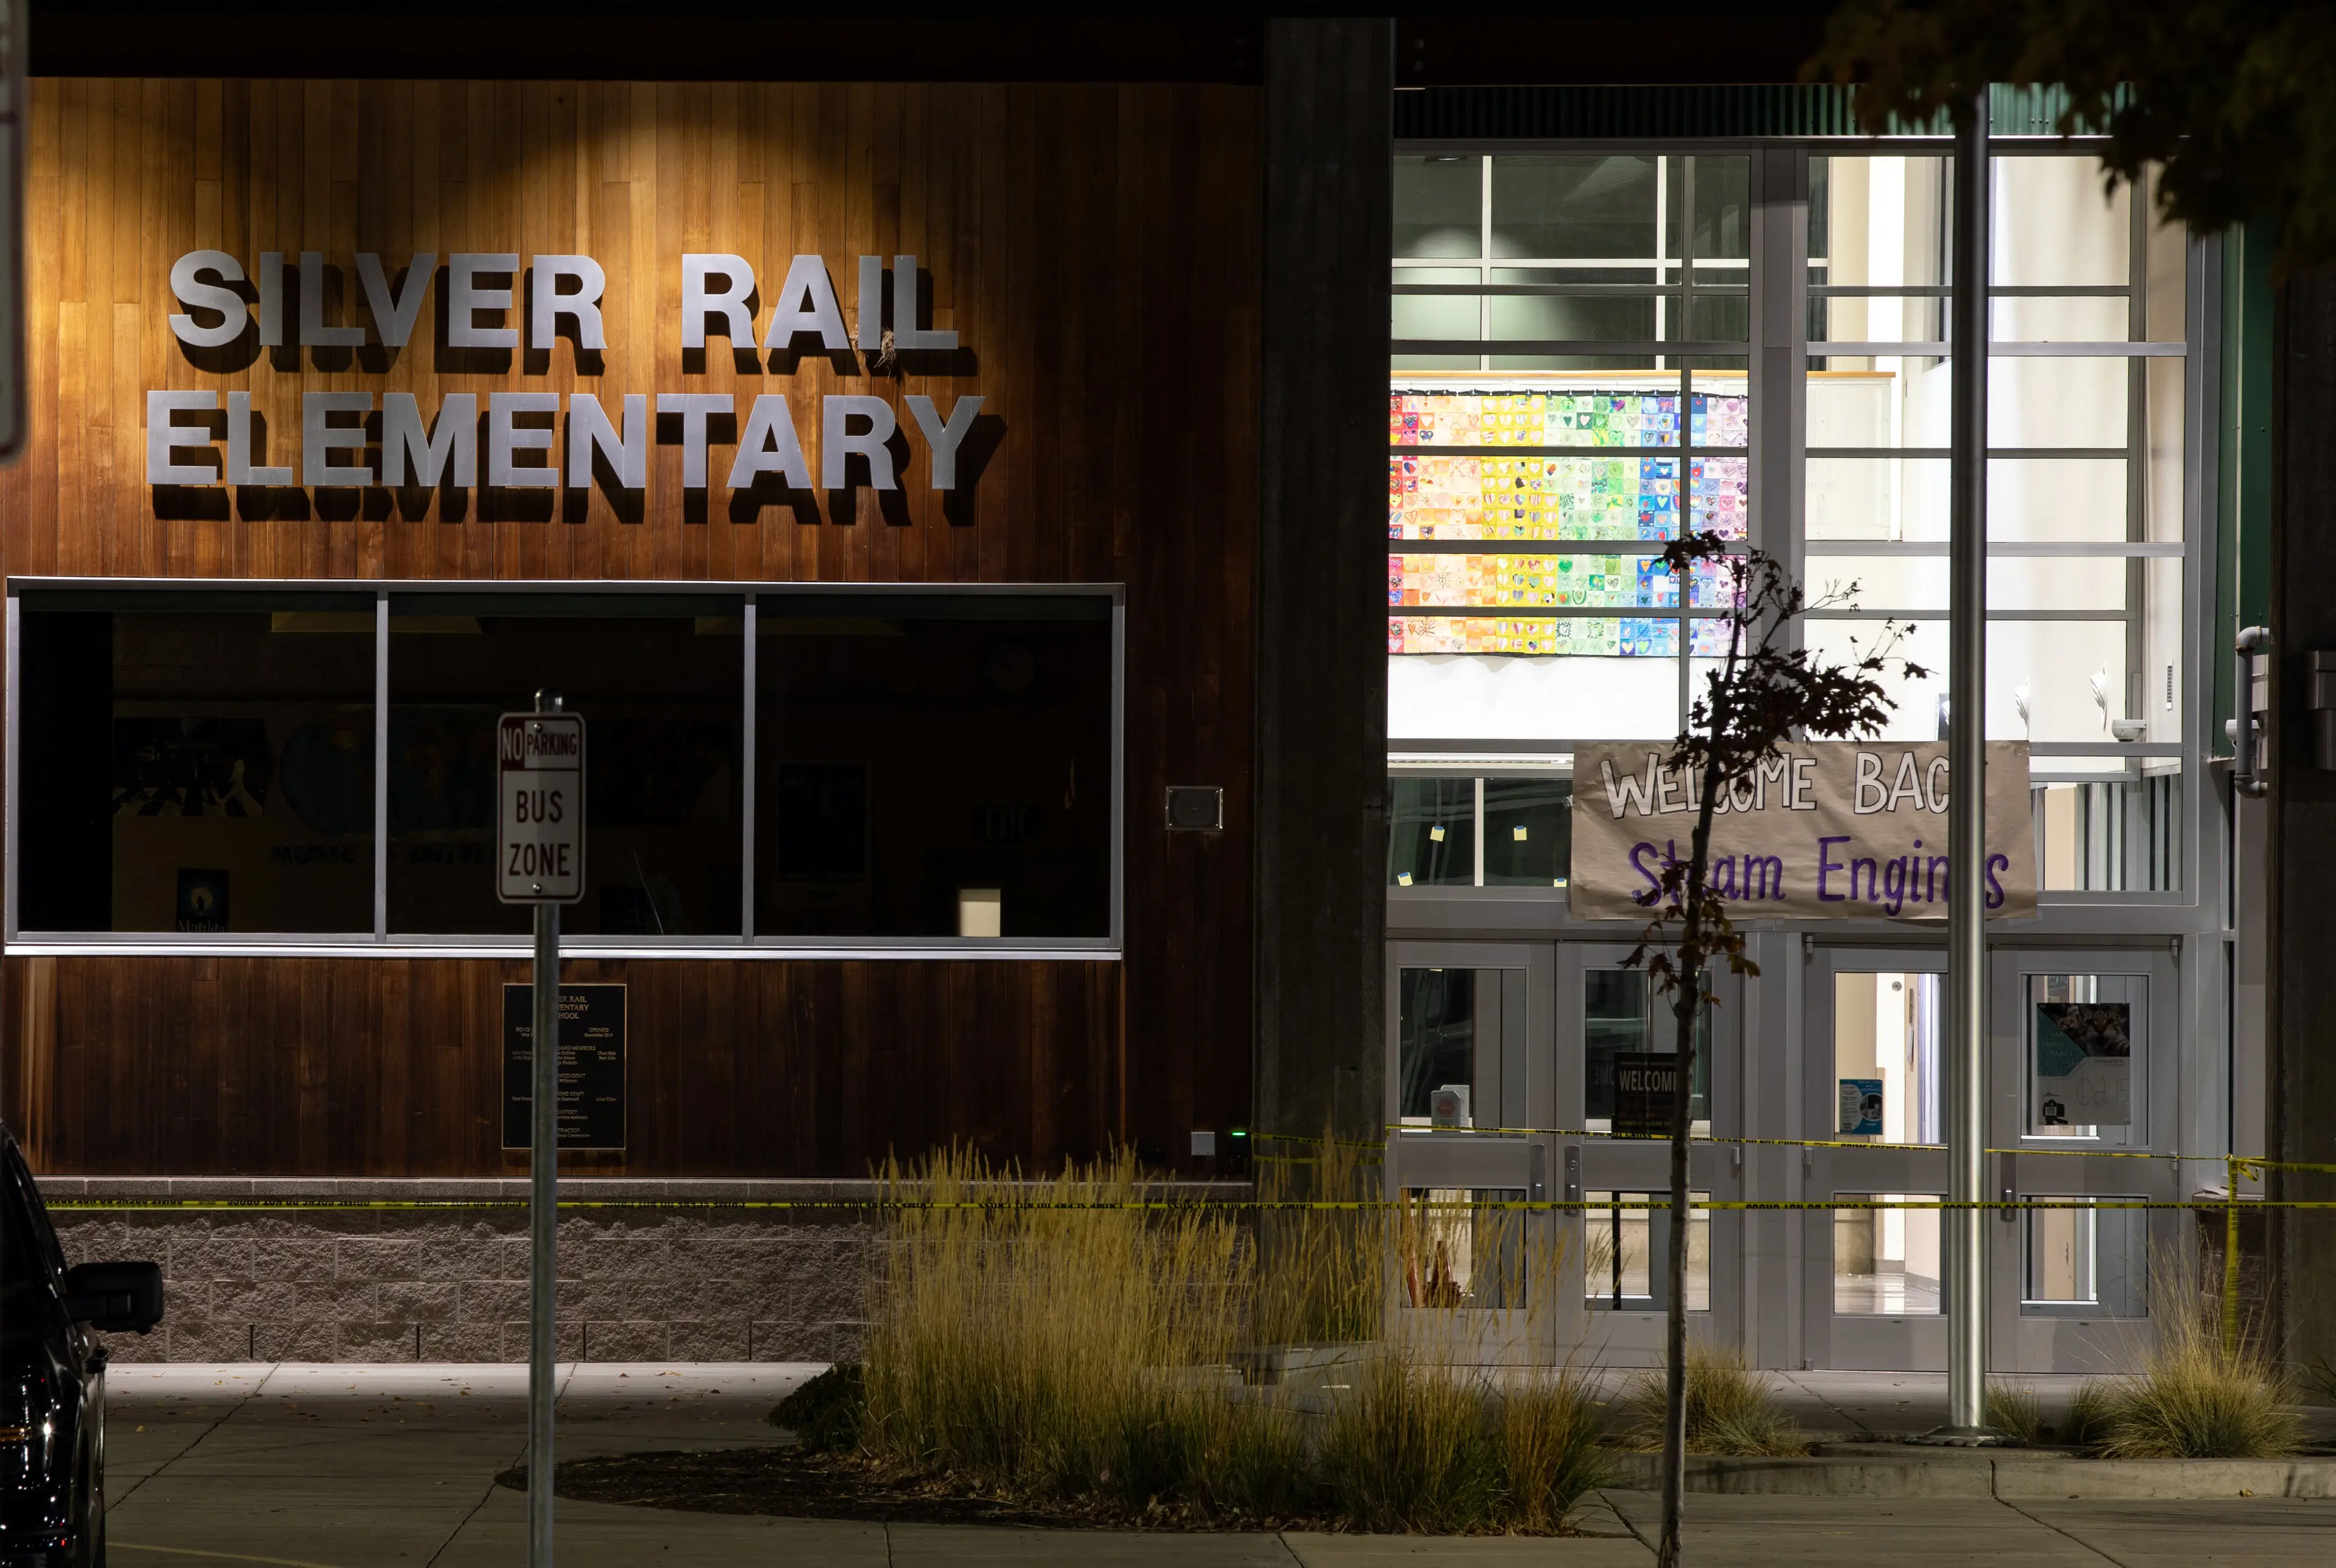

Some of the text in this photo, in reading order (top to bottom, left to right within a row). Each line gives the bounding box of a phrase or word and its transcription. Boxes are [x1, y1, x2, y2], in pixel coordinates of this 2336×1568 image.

[169, 249, 958, 350] SILVER RAIL
[147, 390, 986, 490] ELEMENTARY
[502, 727, 577, 760] NO PARKING
[516, 790, 563, 824] BUS
[1854, 751, 1948, 815] BAC
[509, 843, 571, 876] ZONE
[1629, 835, 2009, 917] Stam Engins
[2076, 1077, 2129, 1105] Oct 15
